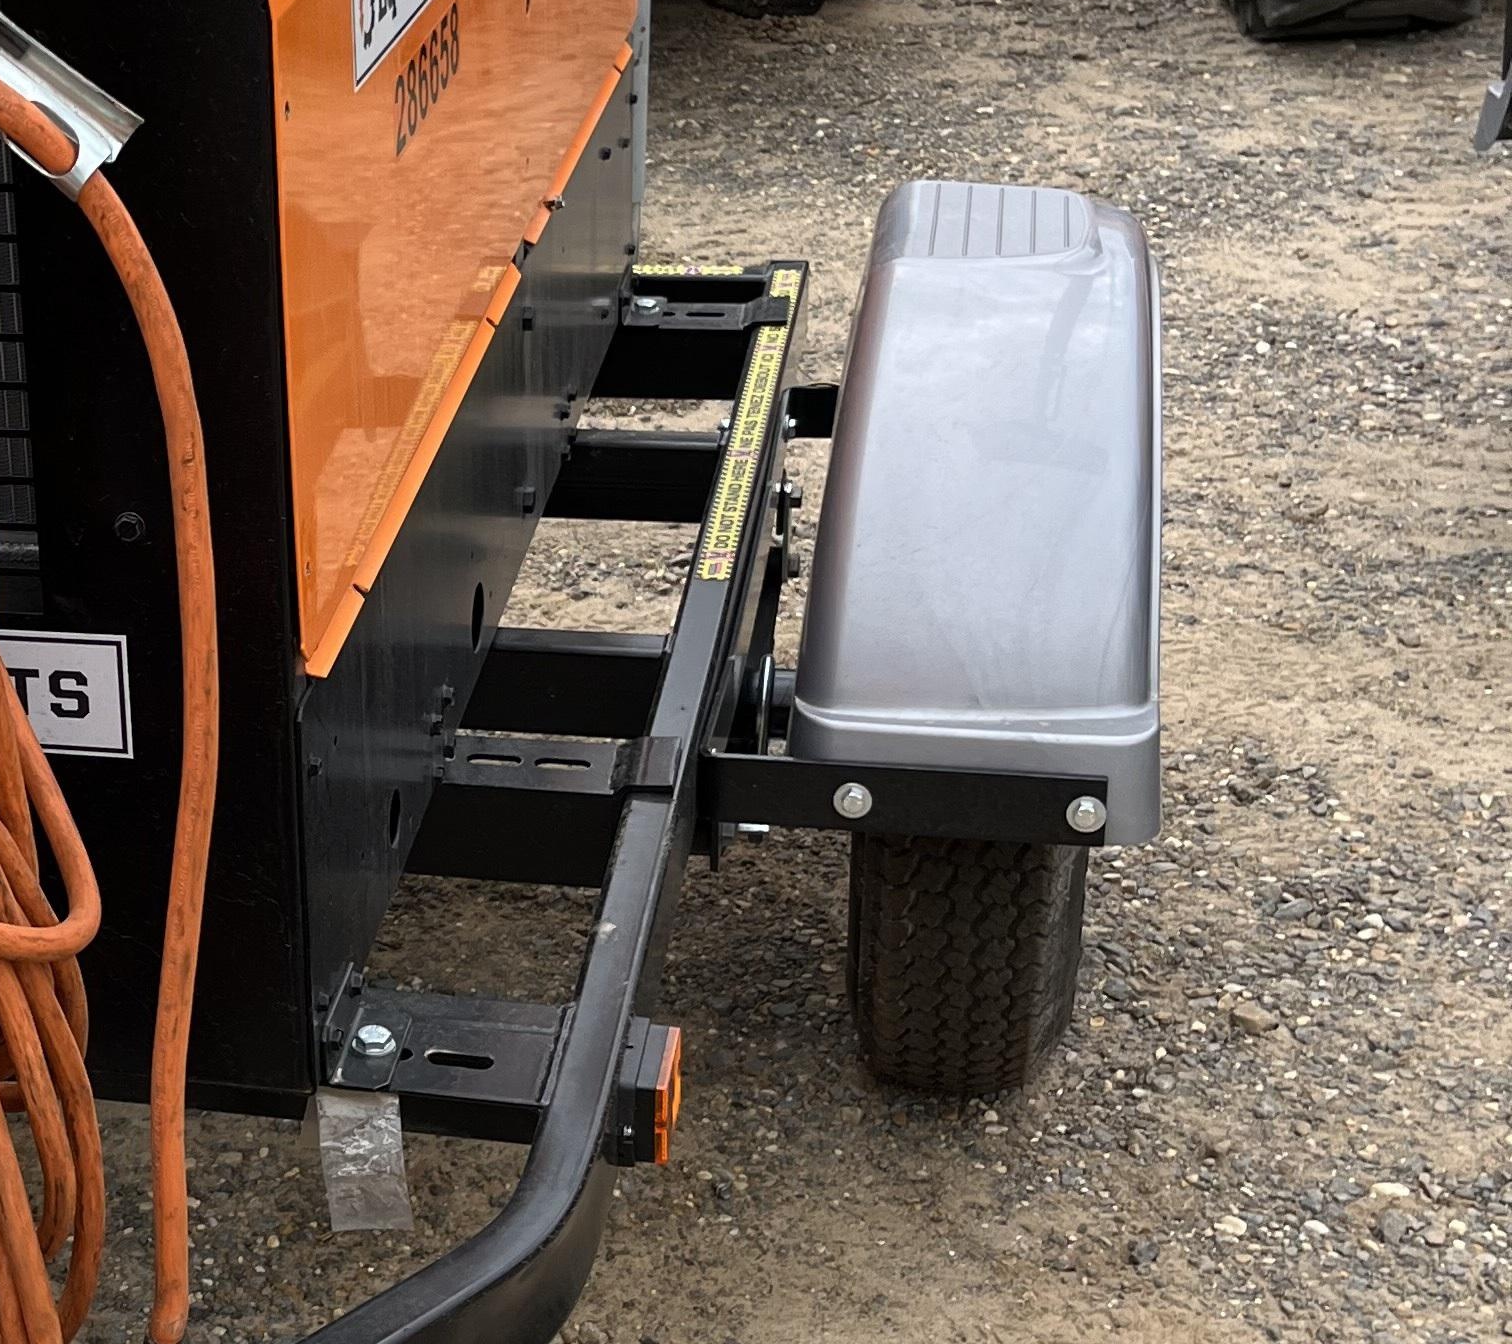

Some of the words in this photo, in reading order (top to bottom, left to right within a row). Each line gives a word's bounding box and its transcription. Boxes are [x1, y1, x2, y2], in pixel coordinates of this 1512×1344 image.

[394, 2, 460, 157] 286658
[721, 483, 742, 512] STAND
[716, 513, 736, 533] NOT
[713, 534, 731, 549] DO
